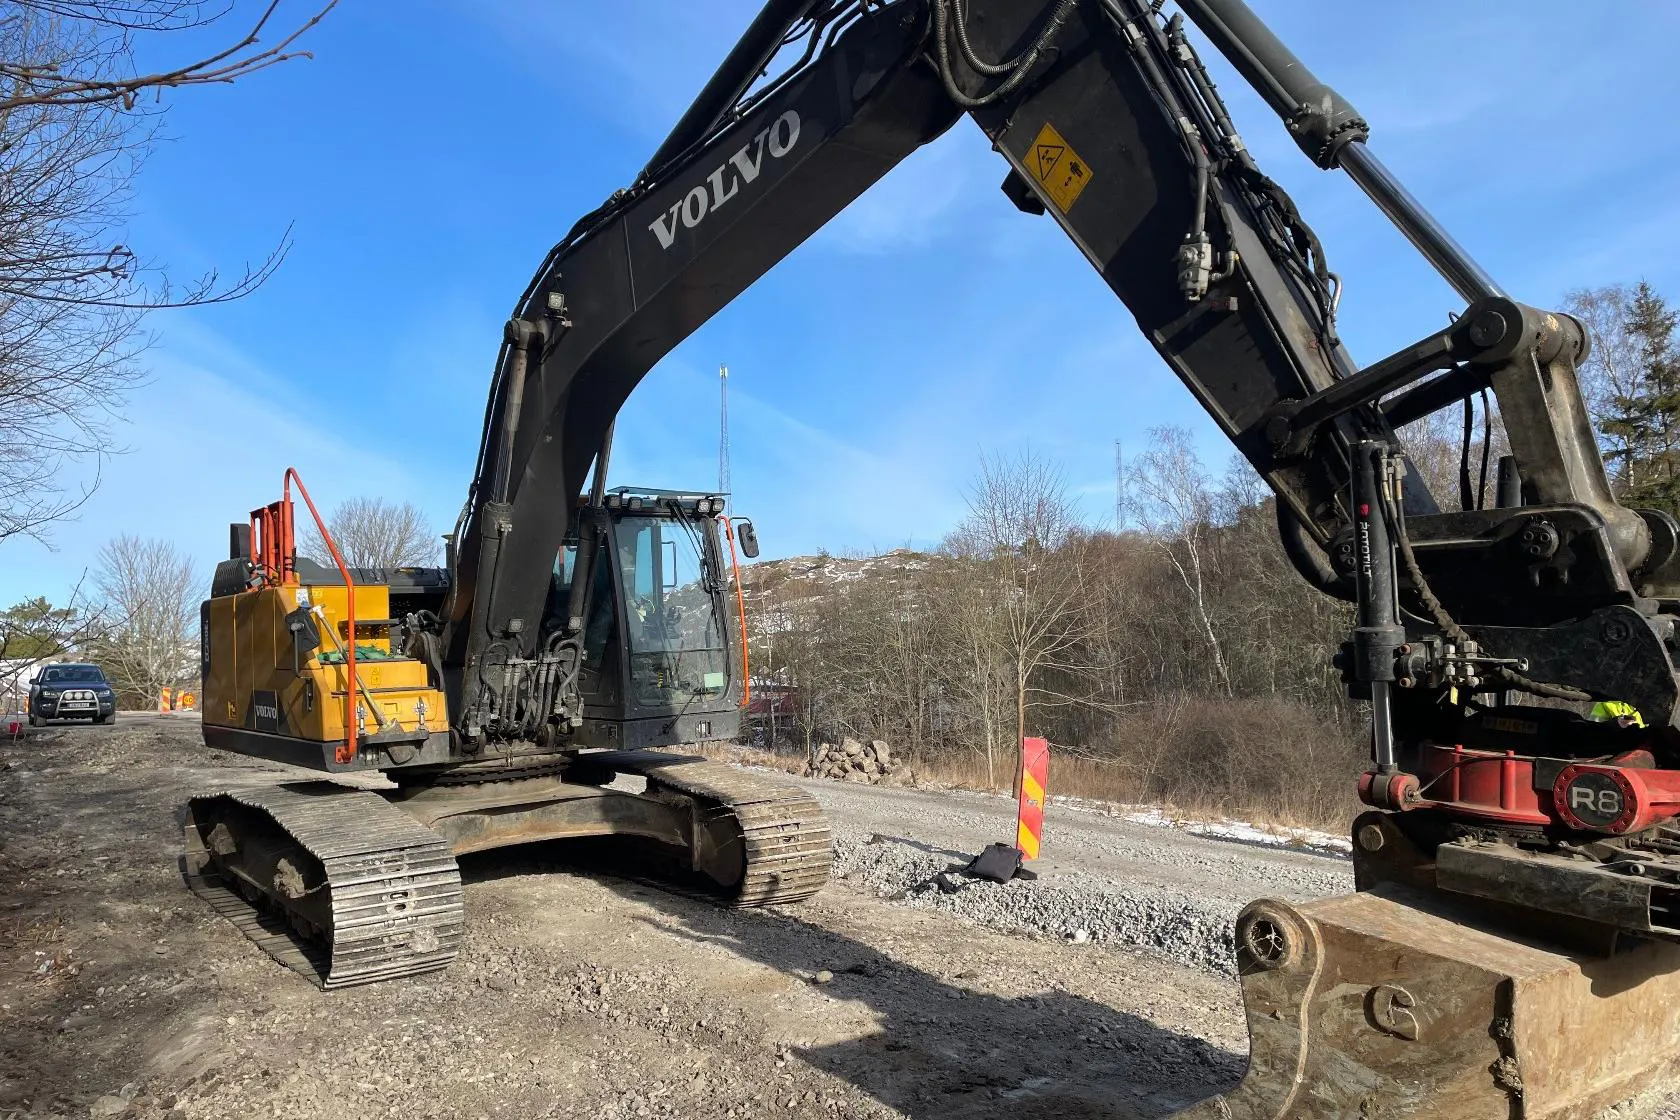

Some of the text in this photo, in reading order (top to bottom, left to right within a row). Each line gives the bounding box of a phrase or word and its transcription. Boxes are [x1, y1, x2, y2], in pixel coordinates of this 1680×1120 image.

[648, 109, 801, 250] VOLVO
[1360, 521, 1372, 577] ROTOTILT
[255, 705, 277, 719] VOLVO
[1572, 786, 1619, 812] R8
